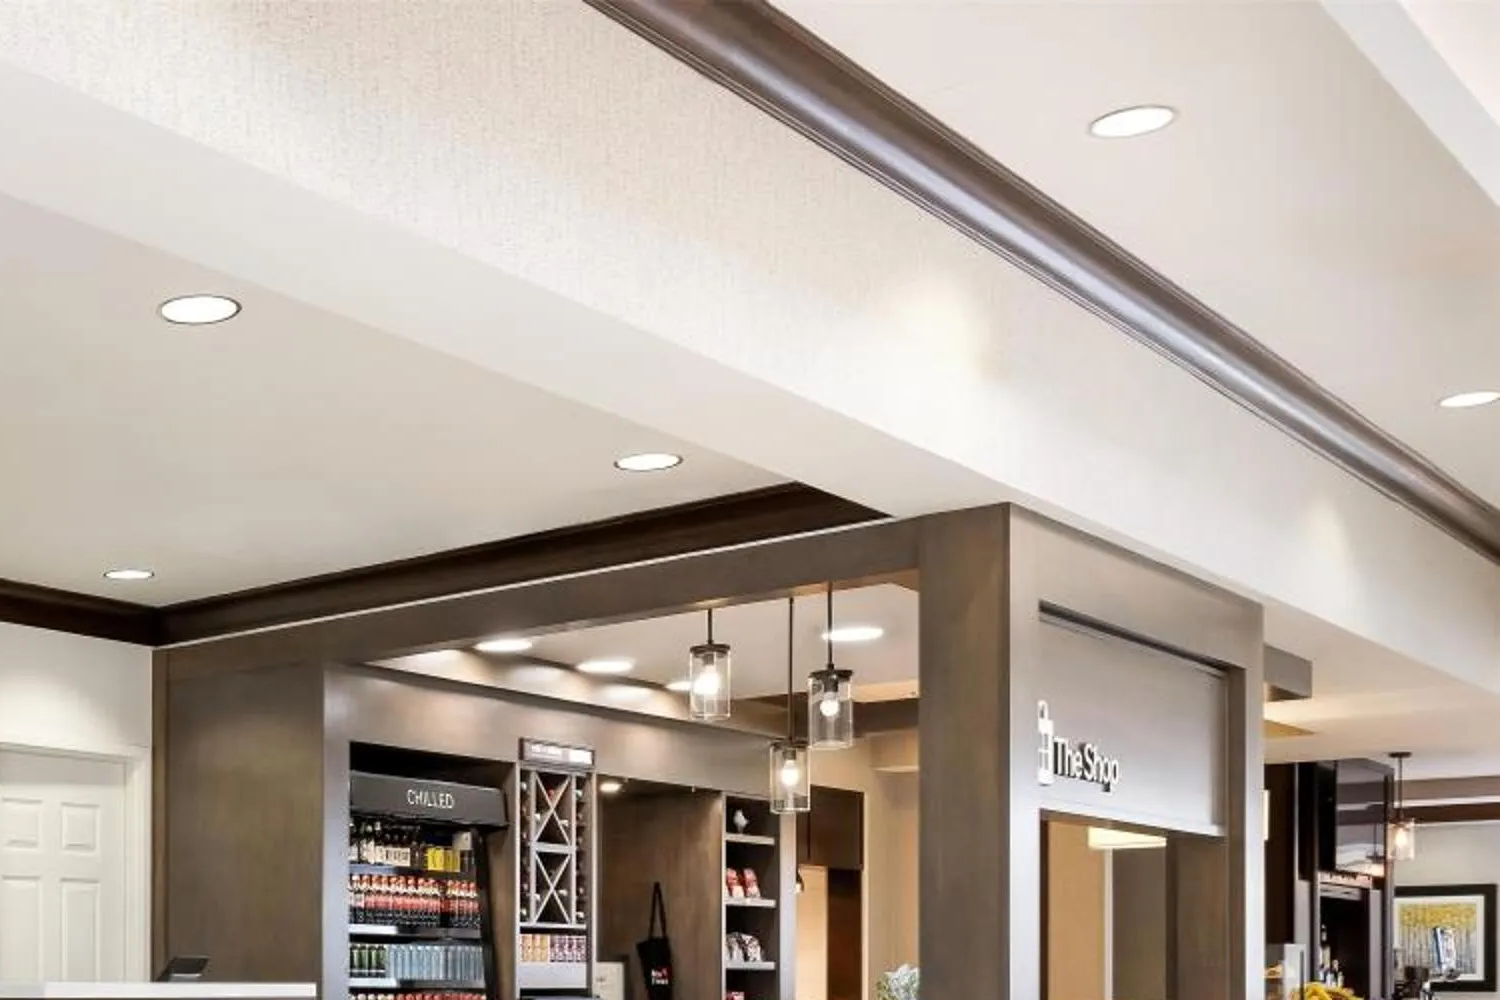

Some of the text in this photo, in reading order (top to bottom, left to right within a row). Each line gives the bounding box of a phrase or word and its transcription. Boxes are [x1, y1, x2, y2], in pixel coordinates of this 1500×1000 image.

[1053, 737, 1119, 795] The Shop
[406, 789, 455, 809] CHILLED
